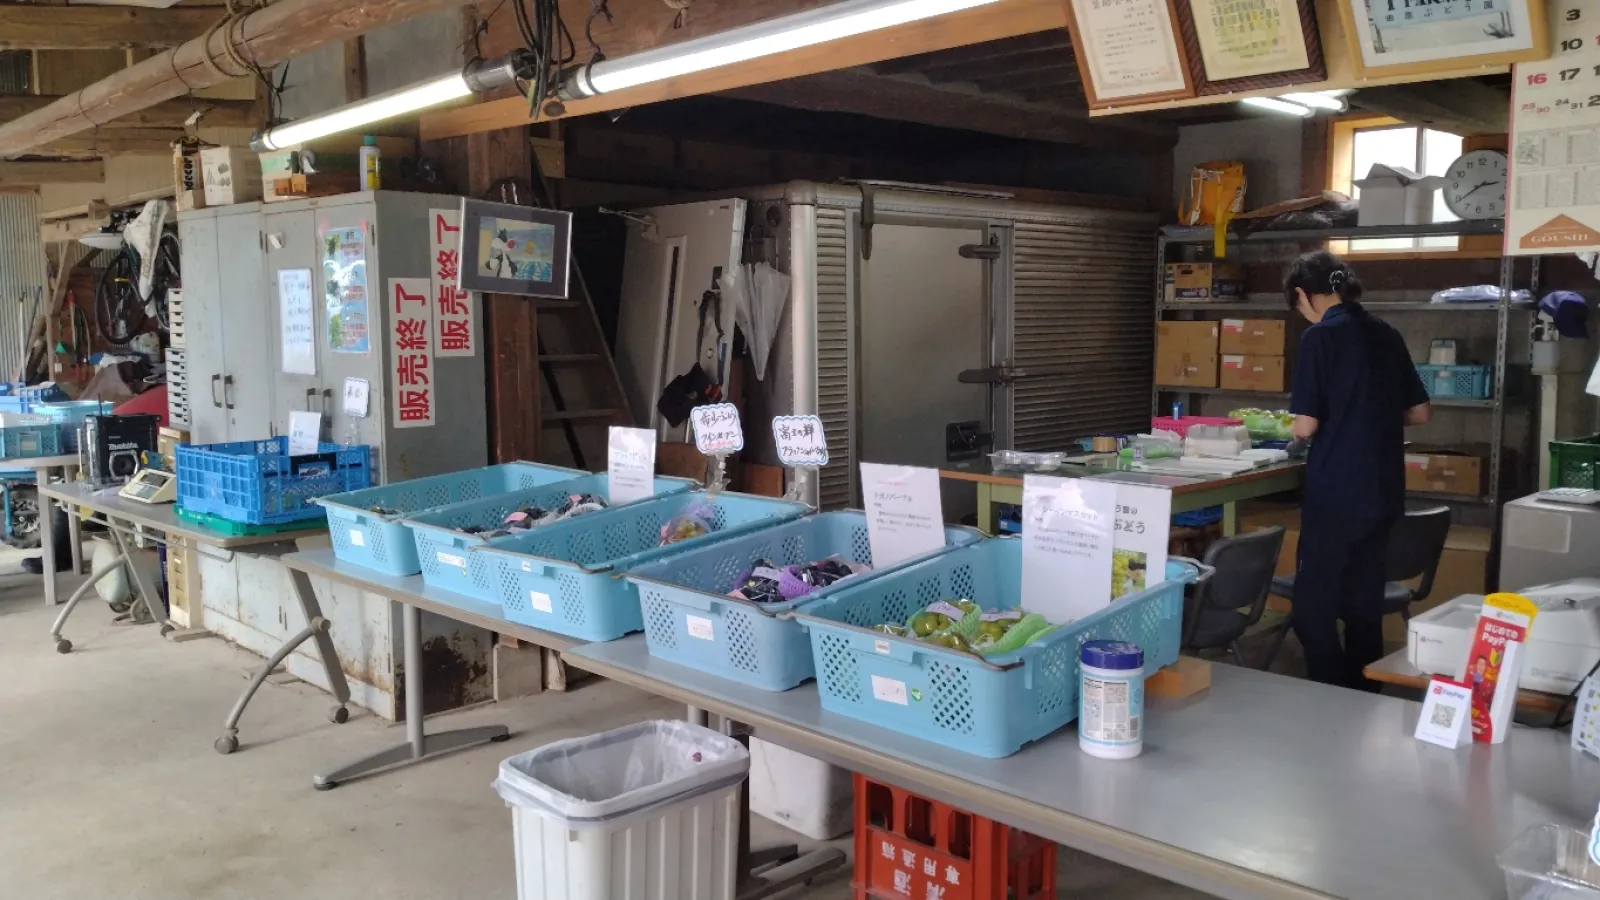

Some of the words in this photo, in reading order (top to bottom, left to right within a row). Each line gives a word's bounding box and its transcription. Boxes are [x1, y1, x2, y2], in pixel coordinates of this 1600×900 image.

[1566, 9, 1581, 21] 3
[1561, 38, 1583, 51] 10
[1527, 73, 1548, 85] 16
[1559, 67, 1581, 81] 17
[1466, 160, 1473, 169] 11
[1478, 157, 1488, 166] 12
[1456, 170, 1466, 178] 10
[1452, 182, 1459, 190] 9
[1464, 203, 1470, 211] 7
[1475, 205, 1481, 213] 6
[1489, 202, 1495, 211] 5
[436, 213, 471, 350] 販売終了
[395, 283, 430, 421] 販売終了
[107, 442, 139, 451] makita
